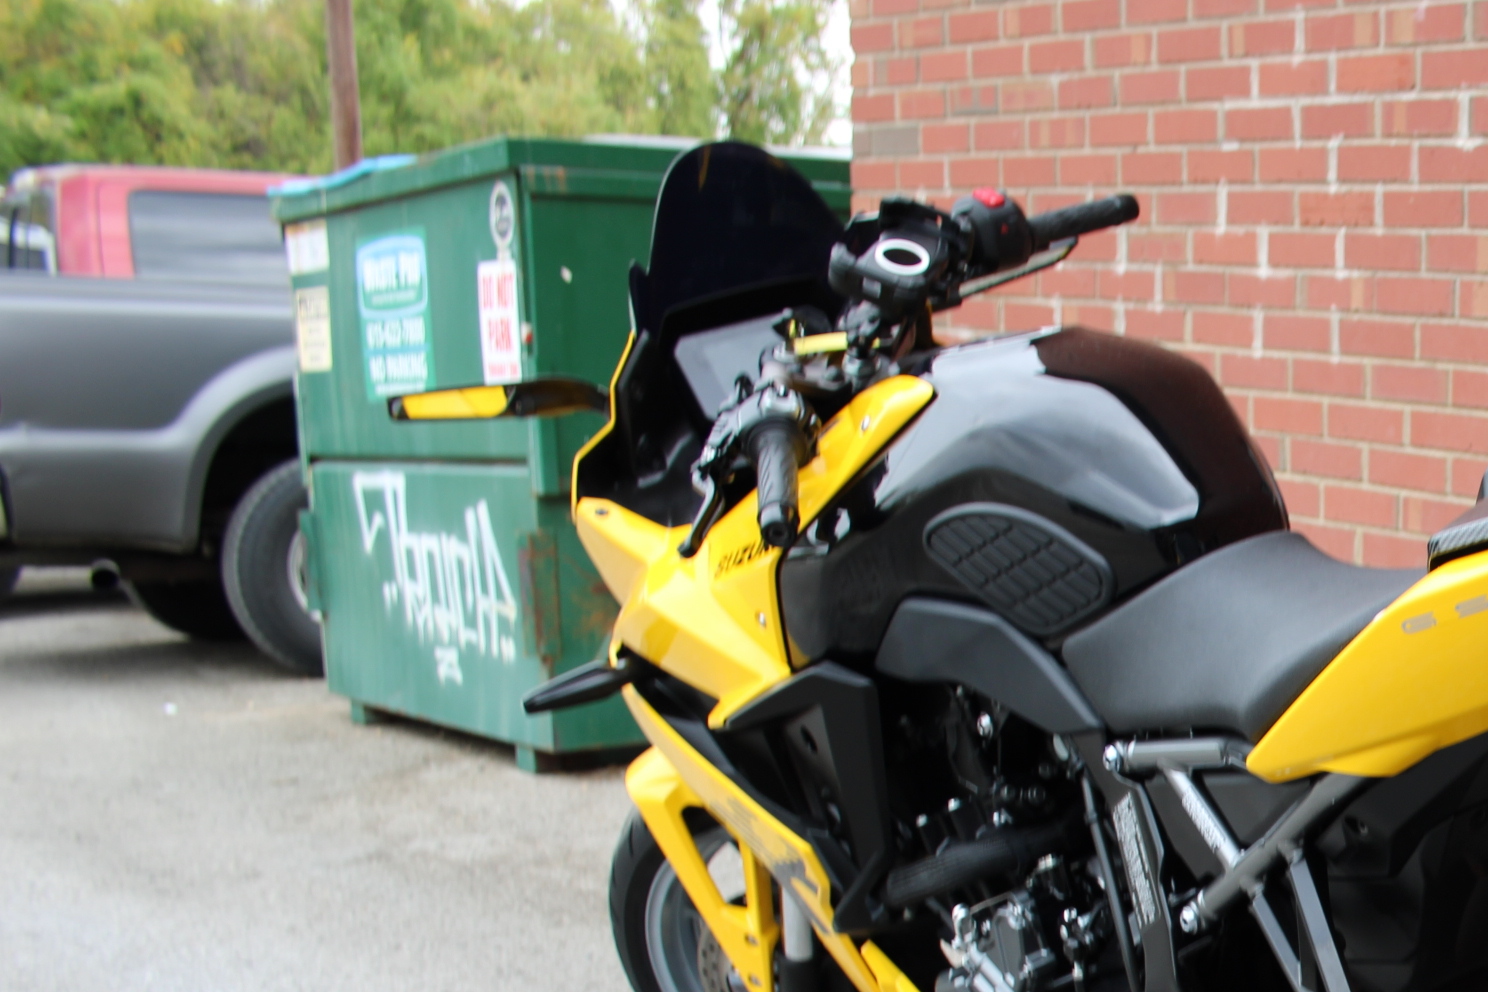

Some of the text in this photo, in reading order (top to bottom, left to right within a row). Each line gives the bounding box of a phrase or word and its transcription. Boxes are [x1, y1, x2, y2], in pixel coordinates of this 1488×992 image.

[482, 272, 514, 309] DO NOT
[488, 318, 512, 352] PARK
[386, 350, 428, 383] PARKING
